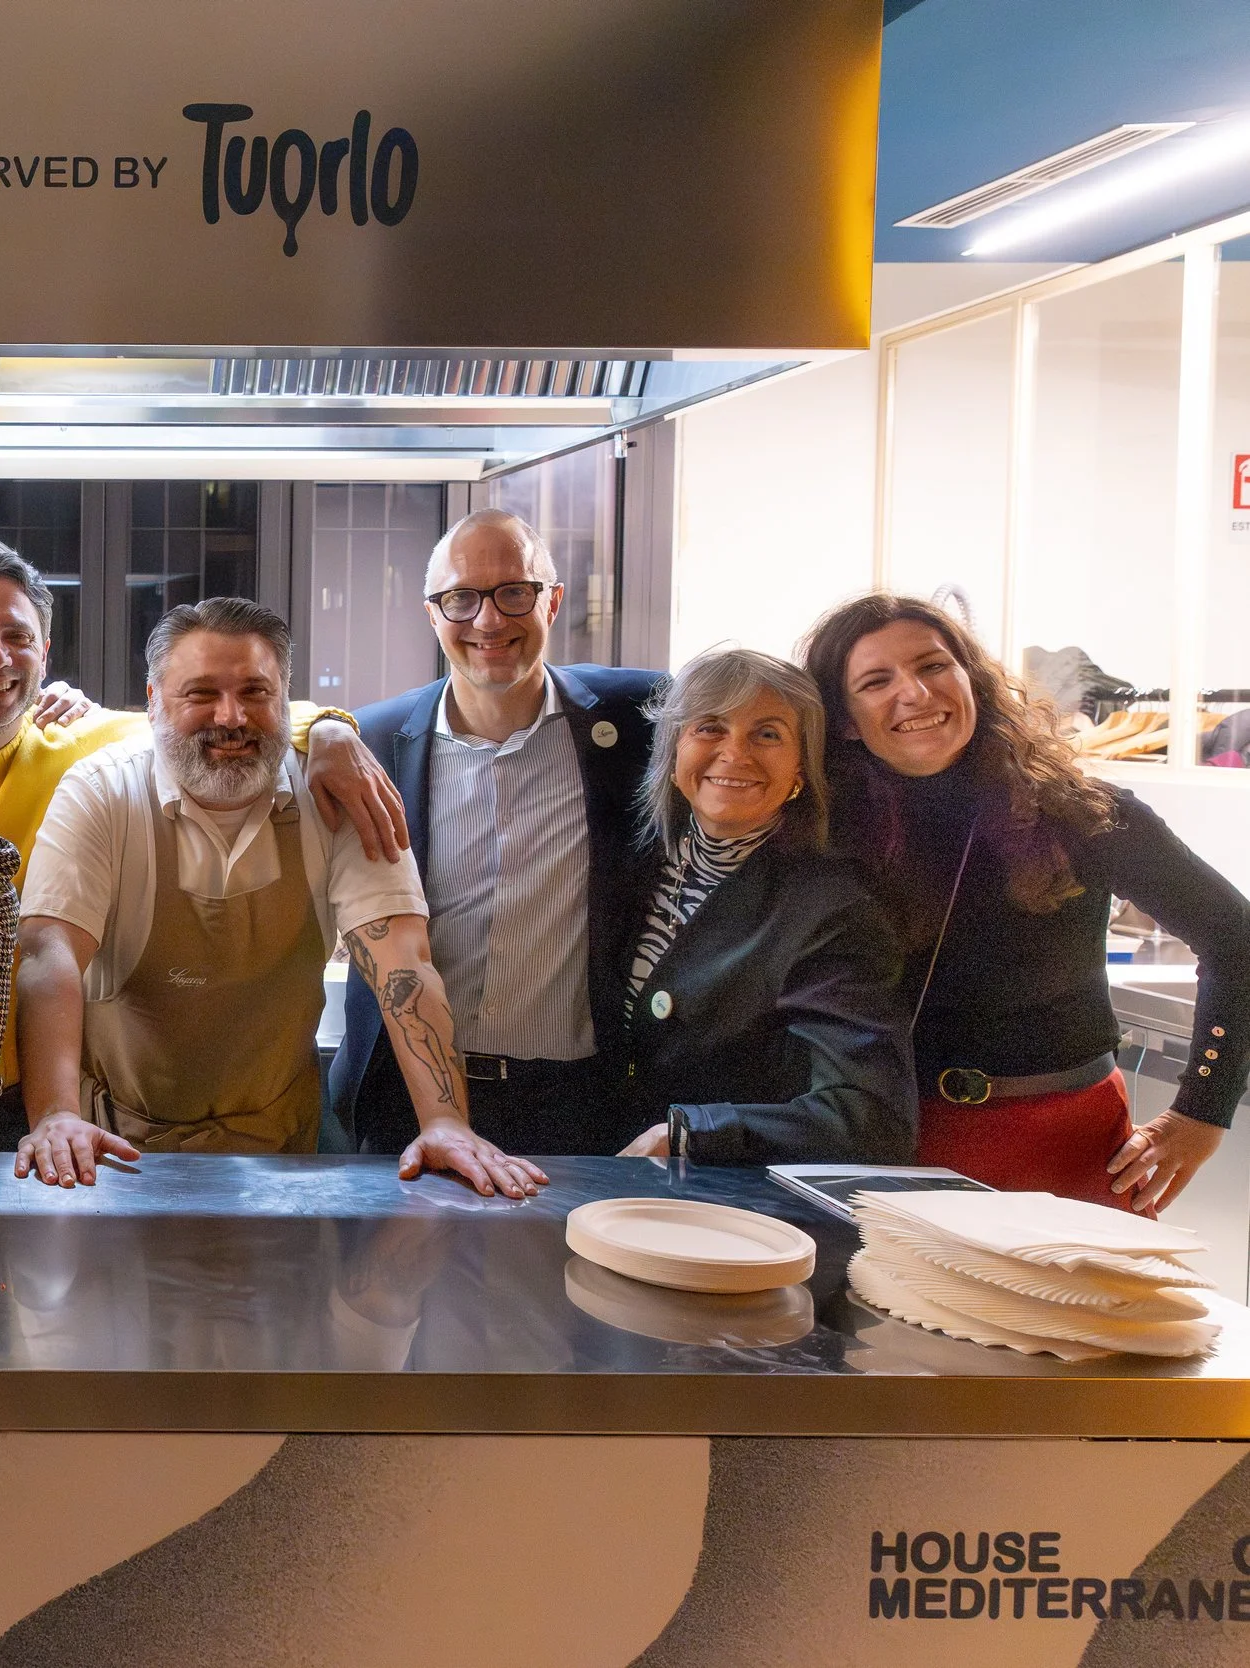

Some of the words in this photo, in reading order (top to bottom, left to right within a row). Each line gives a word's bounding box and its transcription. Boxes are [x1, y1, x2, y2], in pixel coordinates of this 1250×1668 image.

[114, 156, 168, 188] BY
[871, 1531, 1061, 1574] HOUSE
[869, 1577, 1250, 1621] MEDITERRANE
